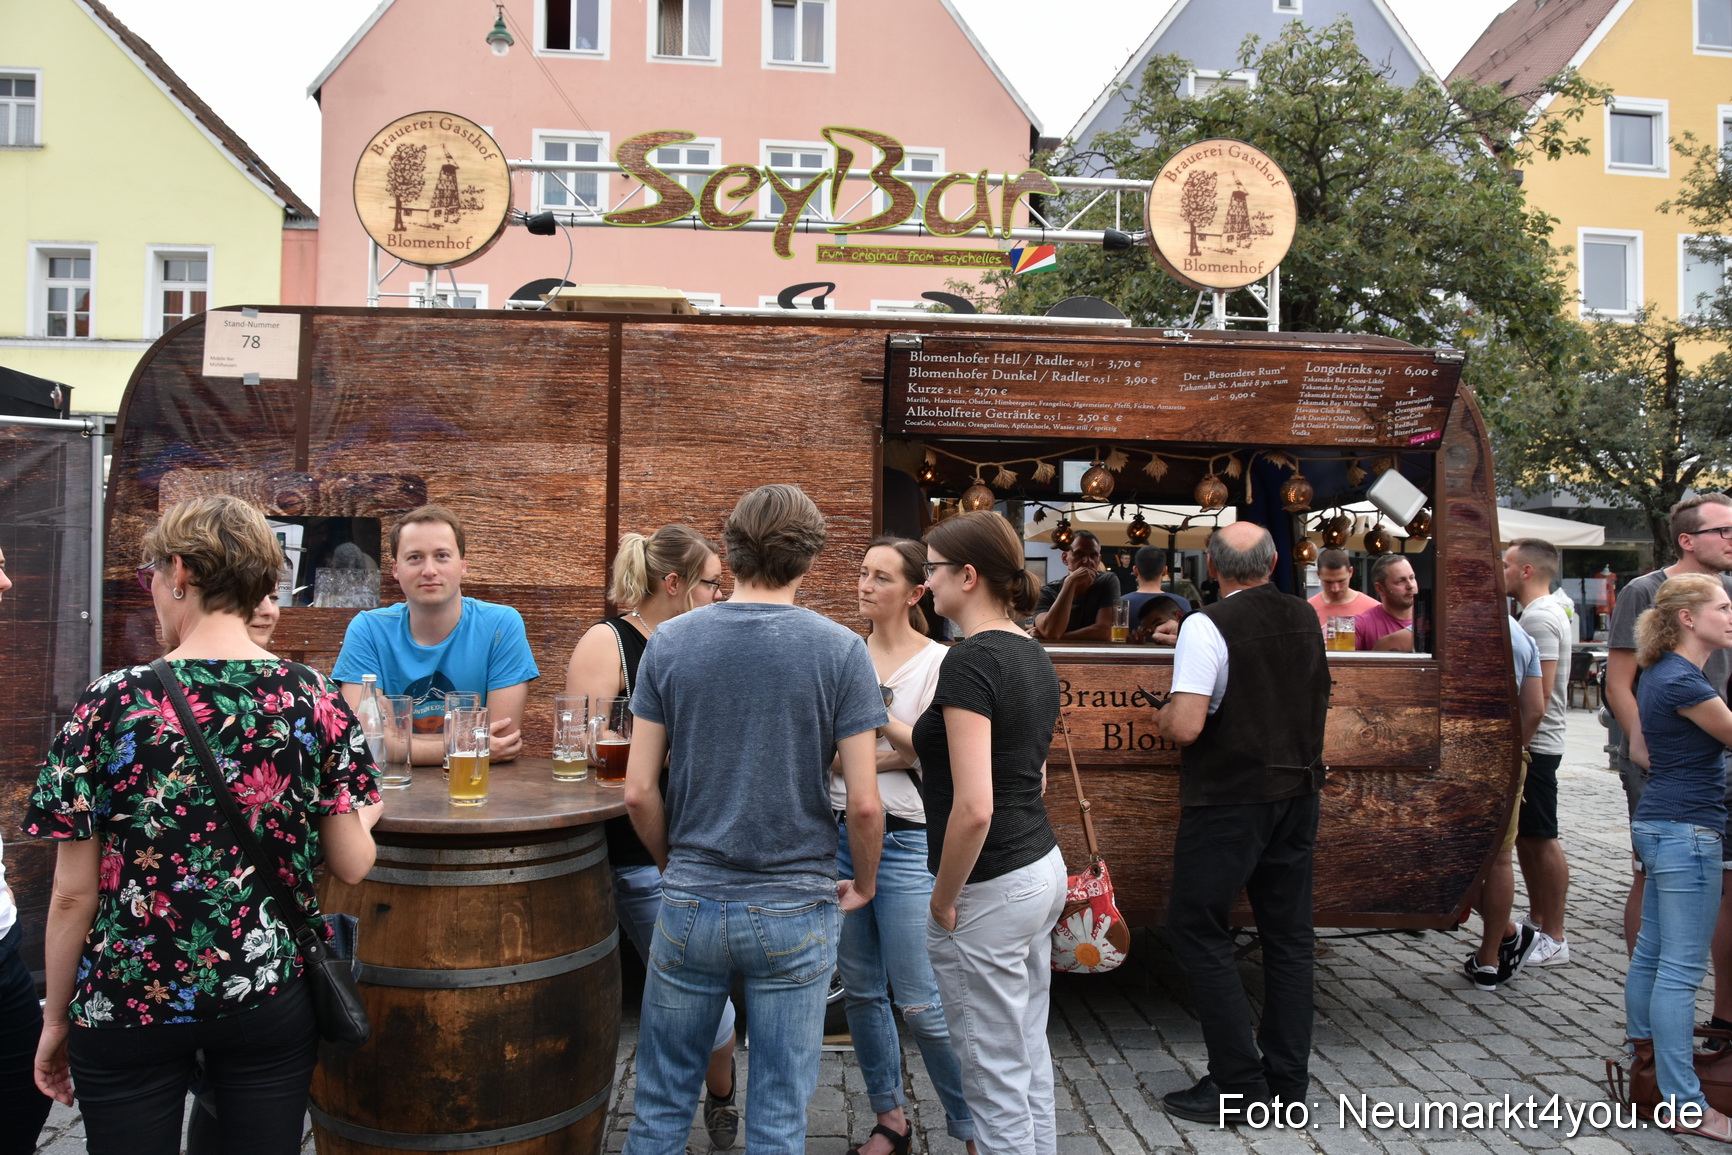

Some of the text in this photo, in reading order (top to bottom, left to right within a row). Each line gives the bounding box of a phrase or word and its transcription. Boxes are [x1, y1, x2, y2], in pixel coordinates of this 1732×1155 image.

[371, 116, 498, 162] Brauerei Gasthof
[1164, 144, 1284, 188] Brauerei Gasthof
[603, 126, 1060, 260] SeyBar
[387, 234, 472, 250] Blomenhof
[822, 250, 1002, 264] rum original from seychelles
[1184, 258, 1264, 274] Blomenhof
[224, 320, 280, 328] Stand-Nummer
[242, 335, 260, 348] 78
[910, 351, 989, 364] Blomenhofer
[994, 353, 1020, 364] Hell
[1035, 355, 1074, 366] Radler
[1108, 360, 1131, 369] 3,70
[909, 367, 988, 379] Blomenhofer
[992, 370, 1036, 380] Dunkel
[1052, 371, 1090, 382] Radler
[1124, 376, 1148, 386] 3,90
[1184, 372, 1201, 380] Der
[1306, 362, 1372, 376] Longdrinks
[1404, 366, 1428, 377] 6,00
[908, 383, 944, 394] Kurze
[974, 388, 998, 397] 2,70
[1179, 383, 1216, 392] Takamaka
[1230, 380, 1252, 388] André
[1230, 392, 1249, 400] 9,00
[906, 406, 981, 418] Alkoholfreie
[986, 408, 1041, 420] Getränke
[1078, 414, 1099, 423] 2,50
